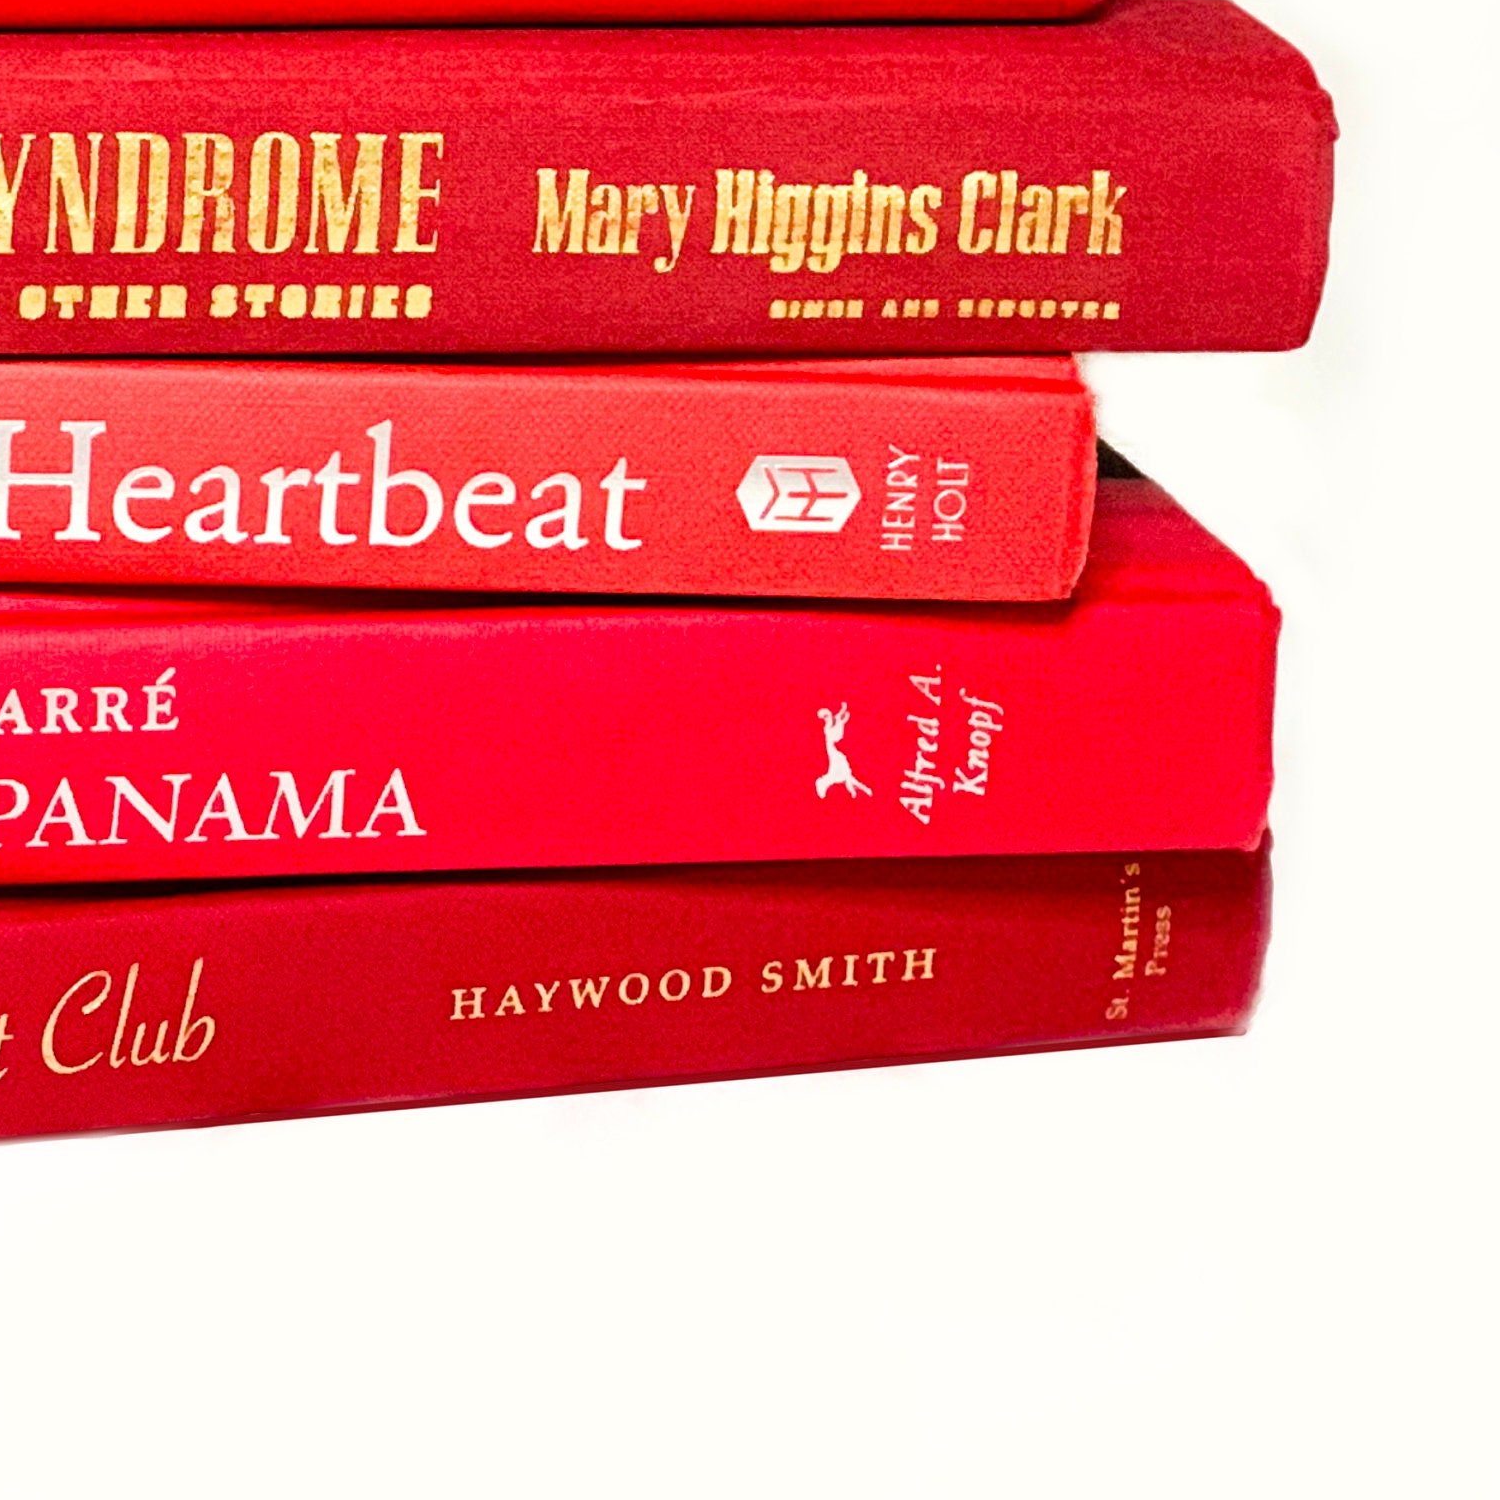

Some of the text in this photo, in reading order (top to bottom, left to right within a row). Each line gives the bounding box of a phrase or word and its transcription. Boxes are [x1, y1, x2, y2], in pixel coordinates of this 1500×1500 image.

[532, 168, 1126, 273] Mary Higgins Clark
[20, 285, 187, 320] OTHER
[211, 285, 432, 318] STORIES
[881, 444, 919, 550] HENRY
[932, 458, 968, 540] HOLT
[900, 664, 945, 824] Alfred A.
[953, 688, 1003, 795] Knopf
[450, 948, 936, 1020] HAYWOOD SMITH
[1145, 906, 1171, 976] Press
[42, 956, 215, 1073] Club
